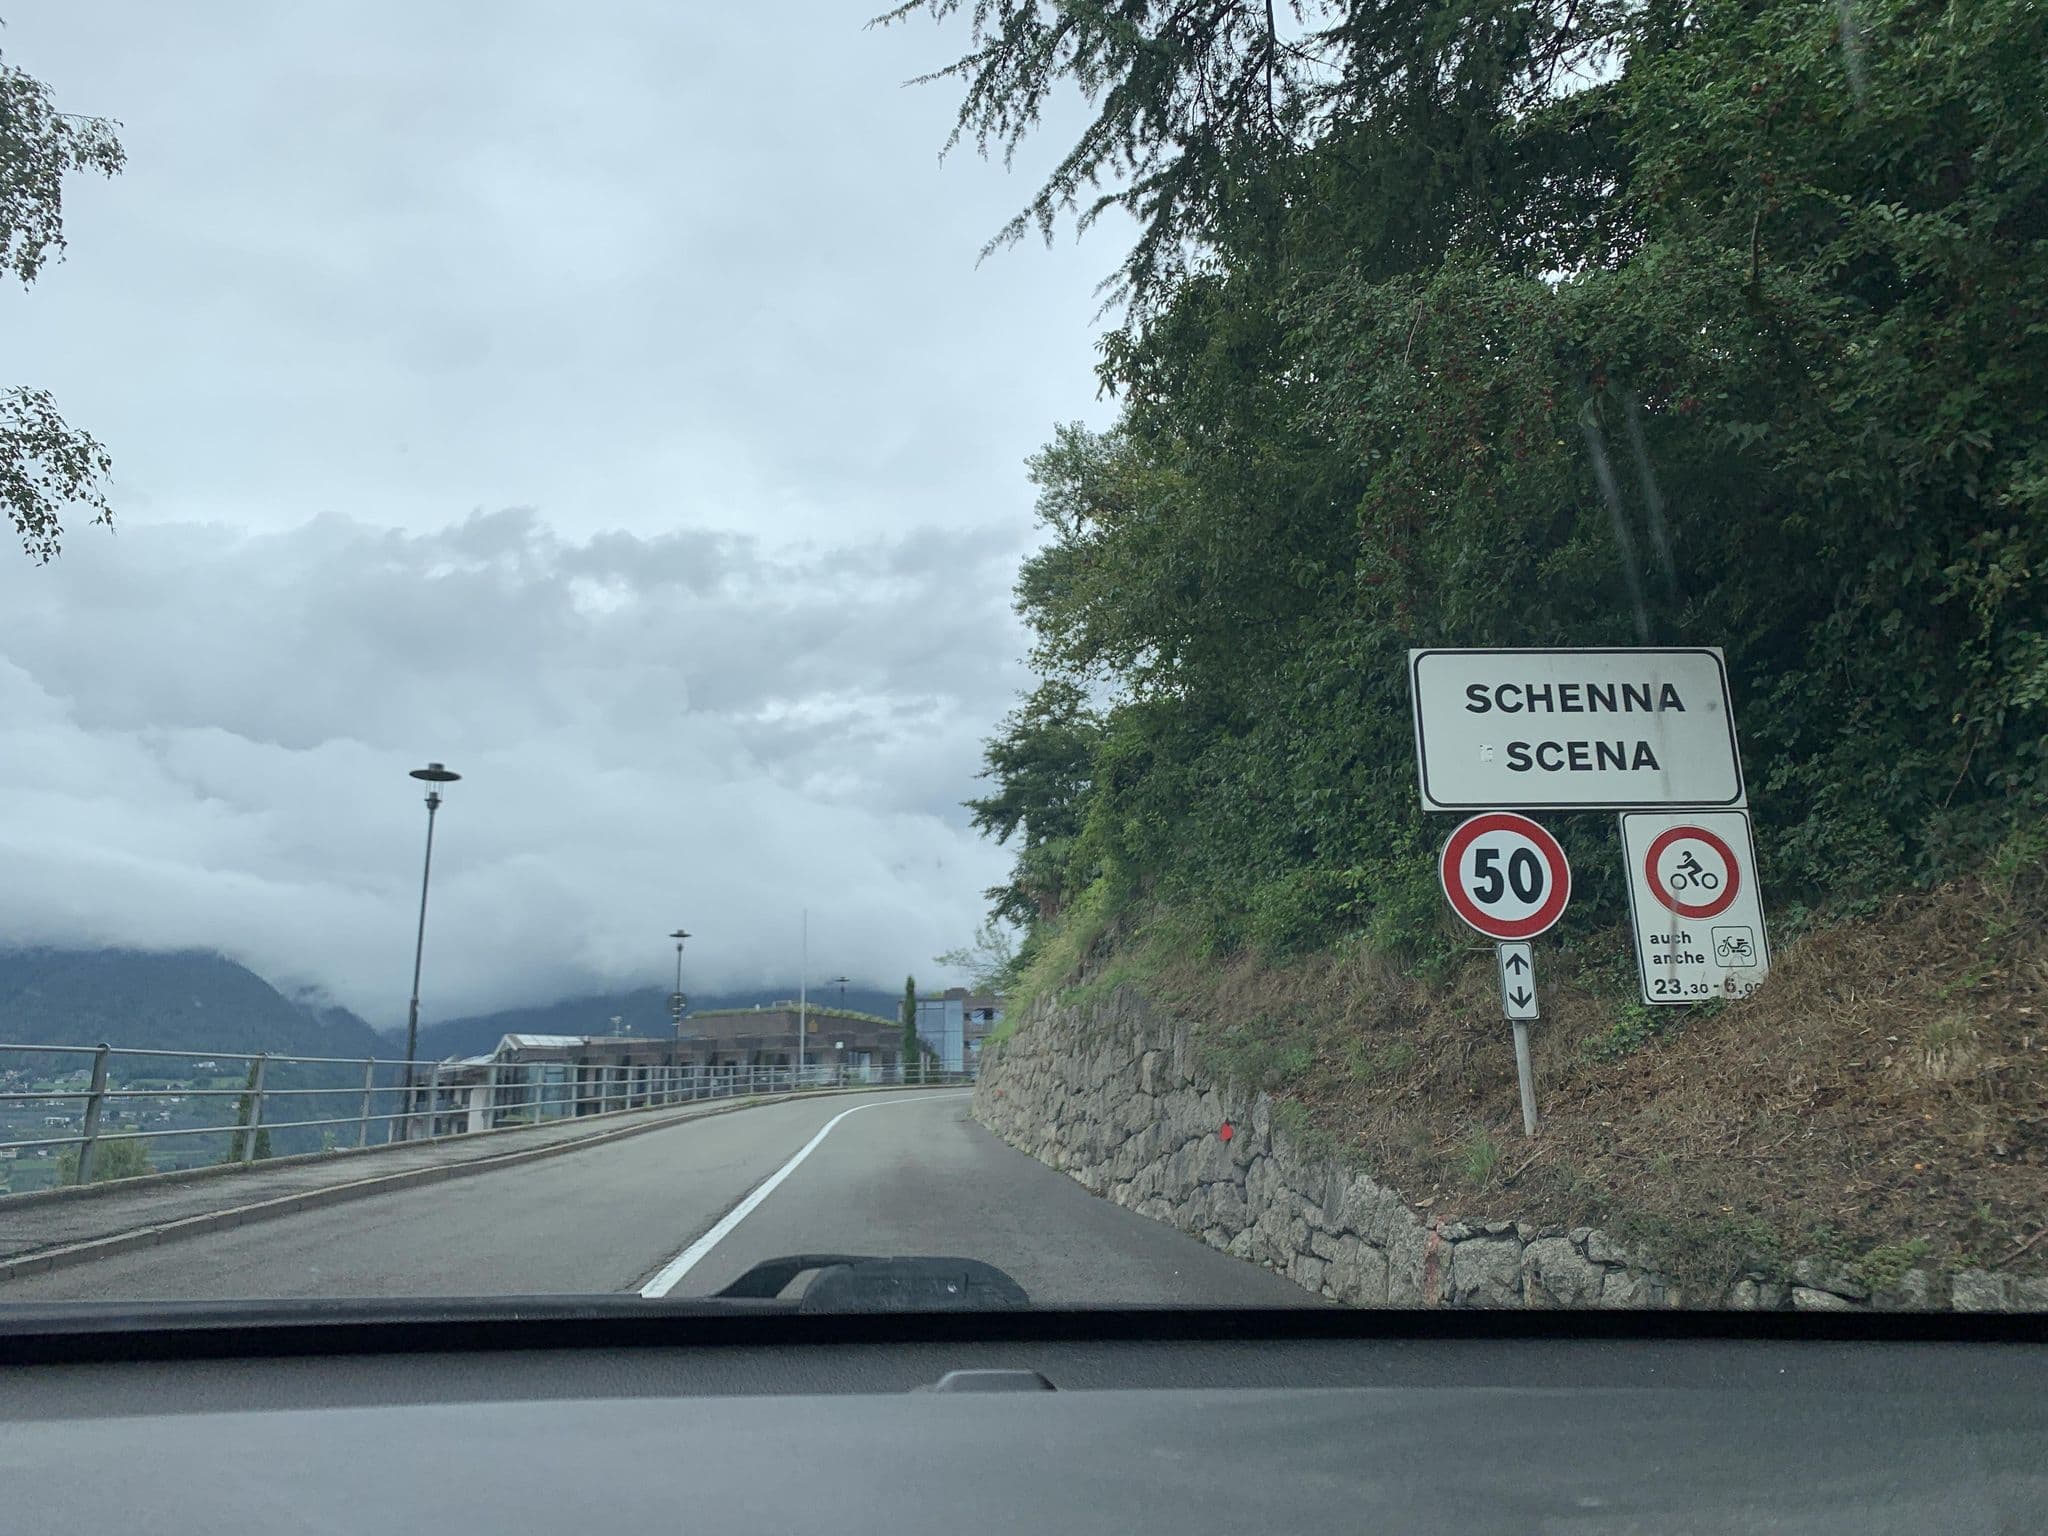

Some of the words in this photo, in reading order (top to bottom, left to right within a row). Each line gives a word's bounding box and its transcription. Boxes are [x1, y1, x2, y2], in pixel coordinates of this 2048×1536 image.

[1465, 683, 1686, 713] SCHENNA
[1506, 741, 1660, 771] SCENA
[1473, 847, 1544, 904] 50
[1650, 931, 1692, 945] auch
[1653, 951, 1705, 964] anche
